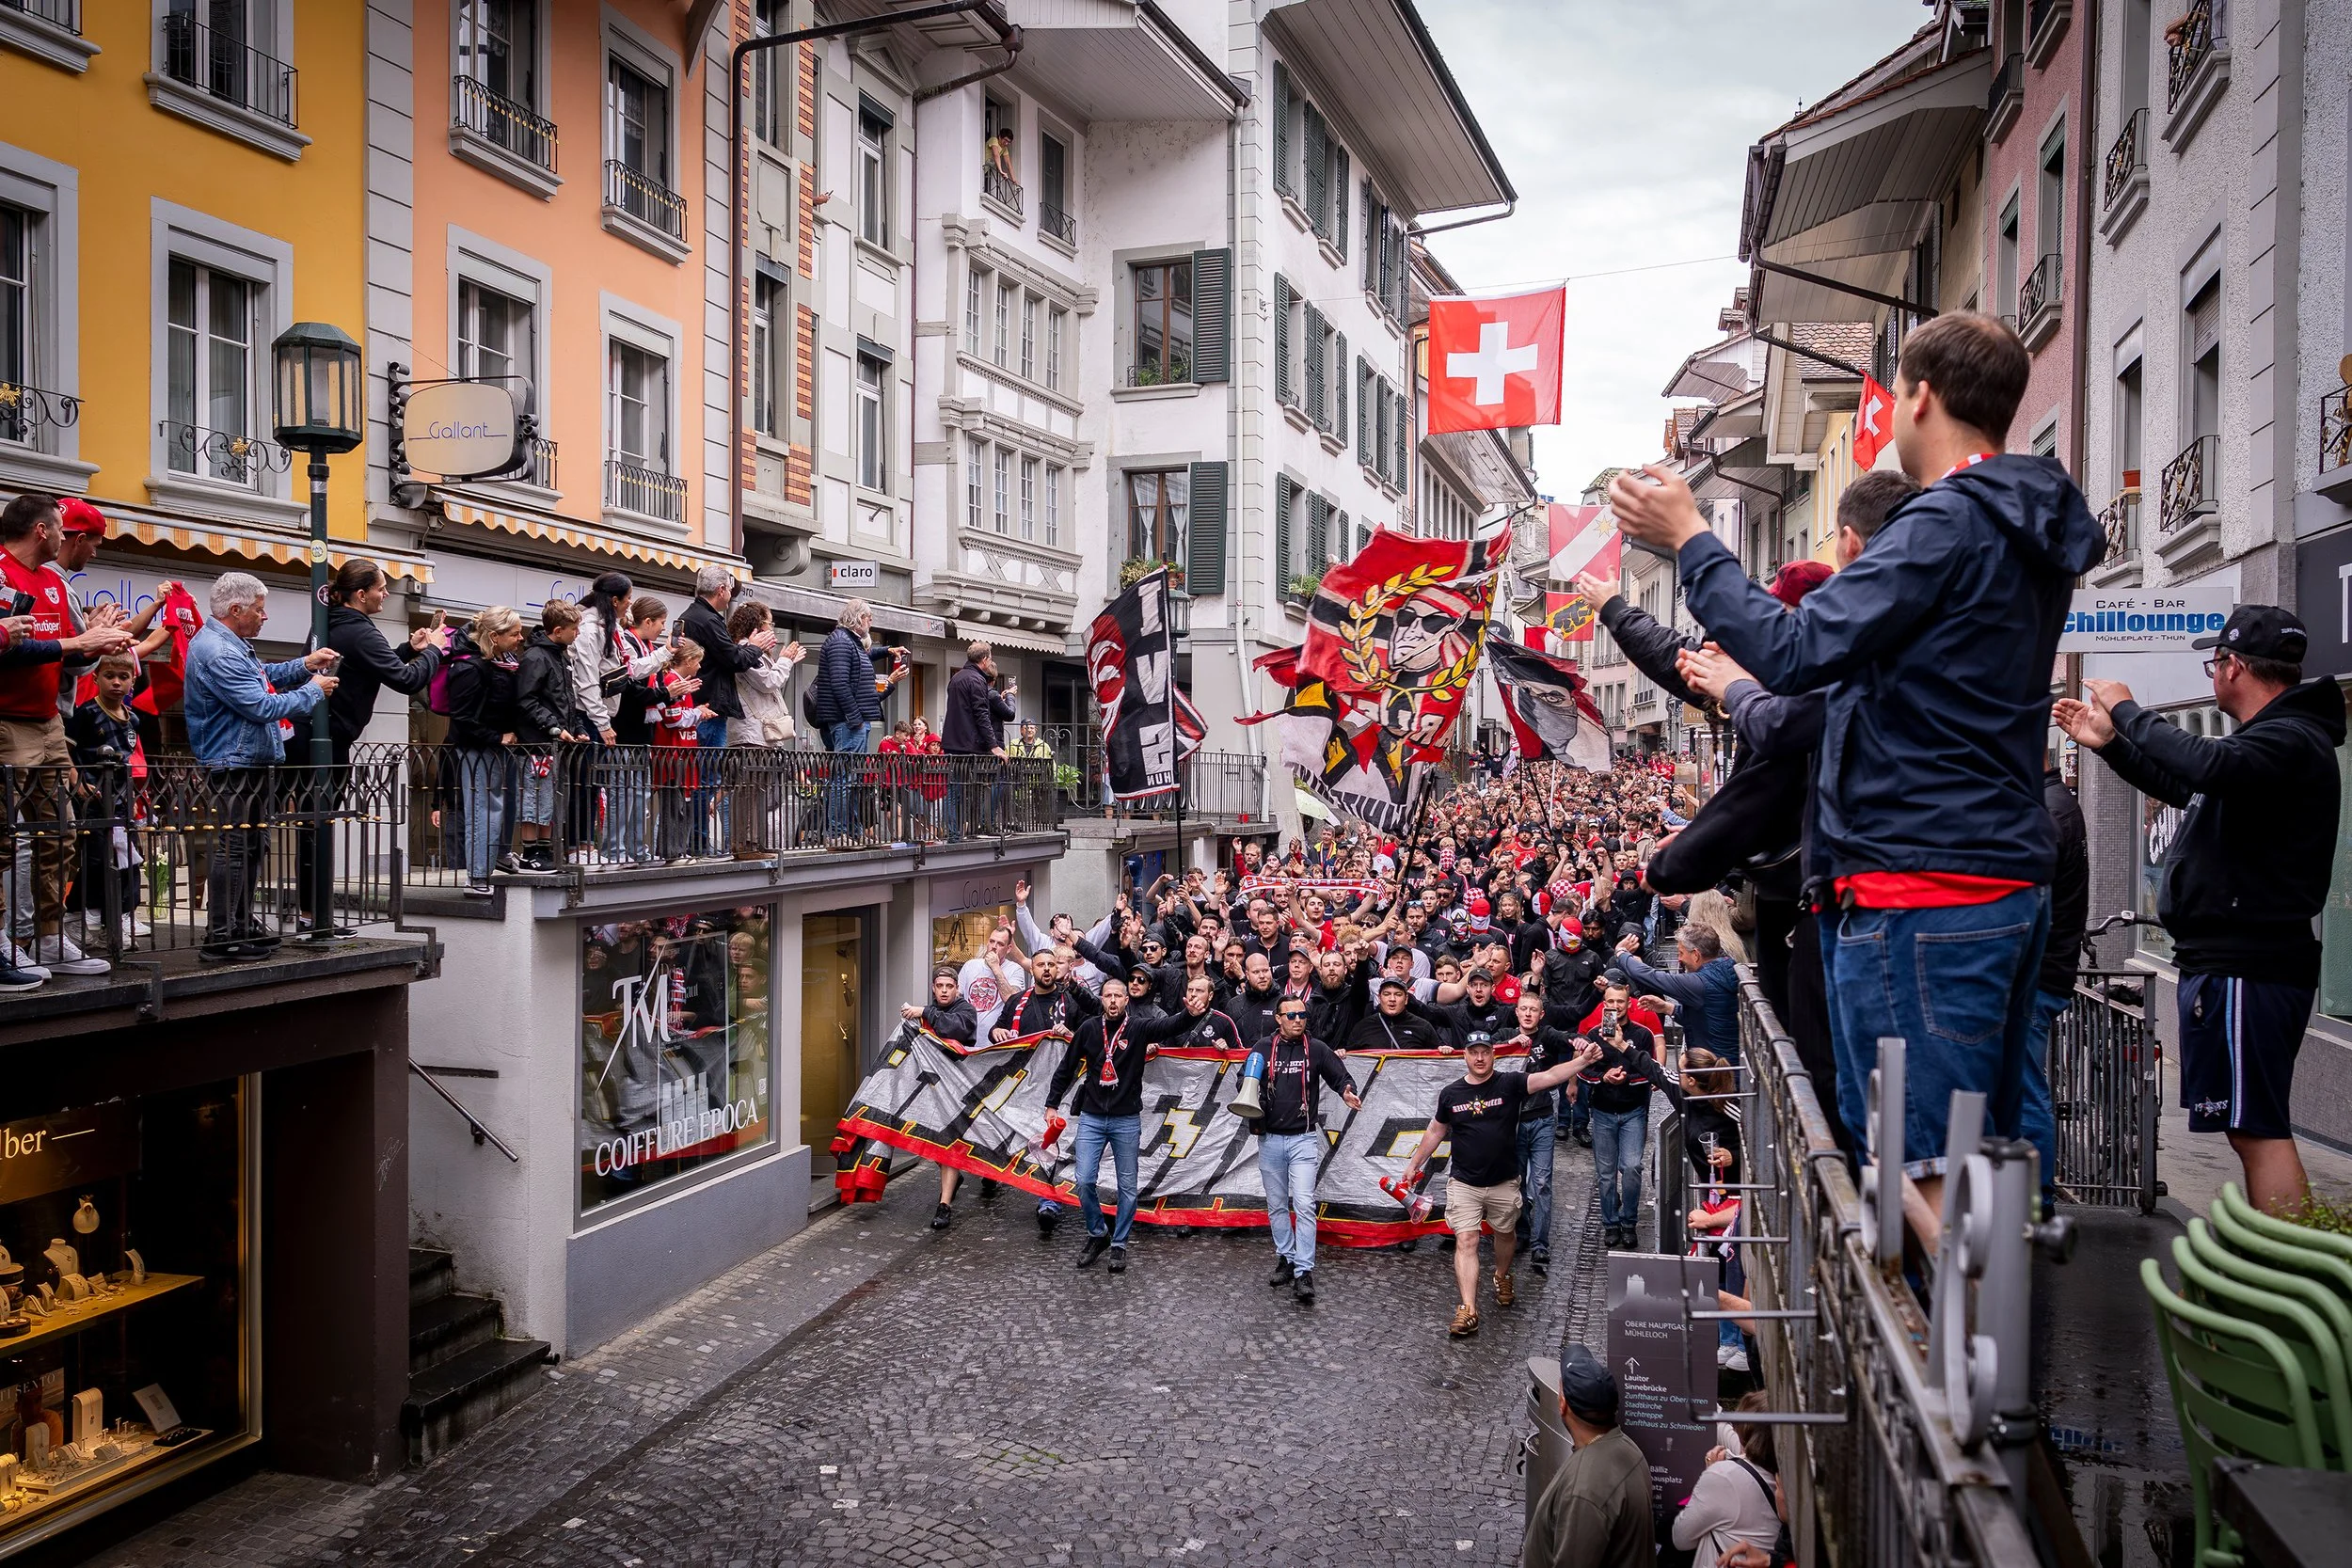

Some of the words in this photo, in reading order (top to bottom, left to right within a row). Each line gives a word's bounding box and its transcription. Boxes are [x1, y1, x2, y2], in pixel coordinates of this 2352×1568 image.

[429, 420, 488, 439] Gallant
[840, 565, 873, 578] claro
[962, 880, 1002, 909] Gallant
[595, 1116, 695, 1177] COIFFURE
[698, 1097, 759, 1142] EPOCA
[1648, 1322, 1693, 1332] HAUPTGASE
[1625, 1329, 1668, 1338] MÜHLELOCH
[1624, 1383, 1667, 1392] Sinnebrücke
[1624, 1392, 1659, 1402] Zunfthaus
[1669, 1395, 1708, 1405] Obererren
[1625, 1401, 1662, 1410] Stadtkirche
[1625, 1410, 1663, 1420] Kirchtreppe
[1625, 1418, 1659, 1428] Zunfthaus
[1669, 1421, 1707, 1432] Schmieden
[1649, 1465, 1669, 1474] Bälliz
